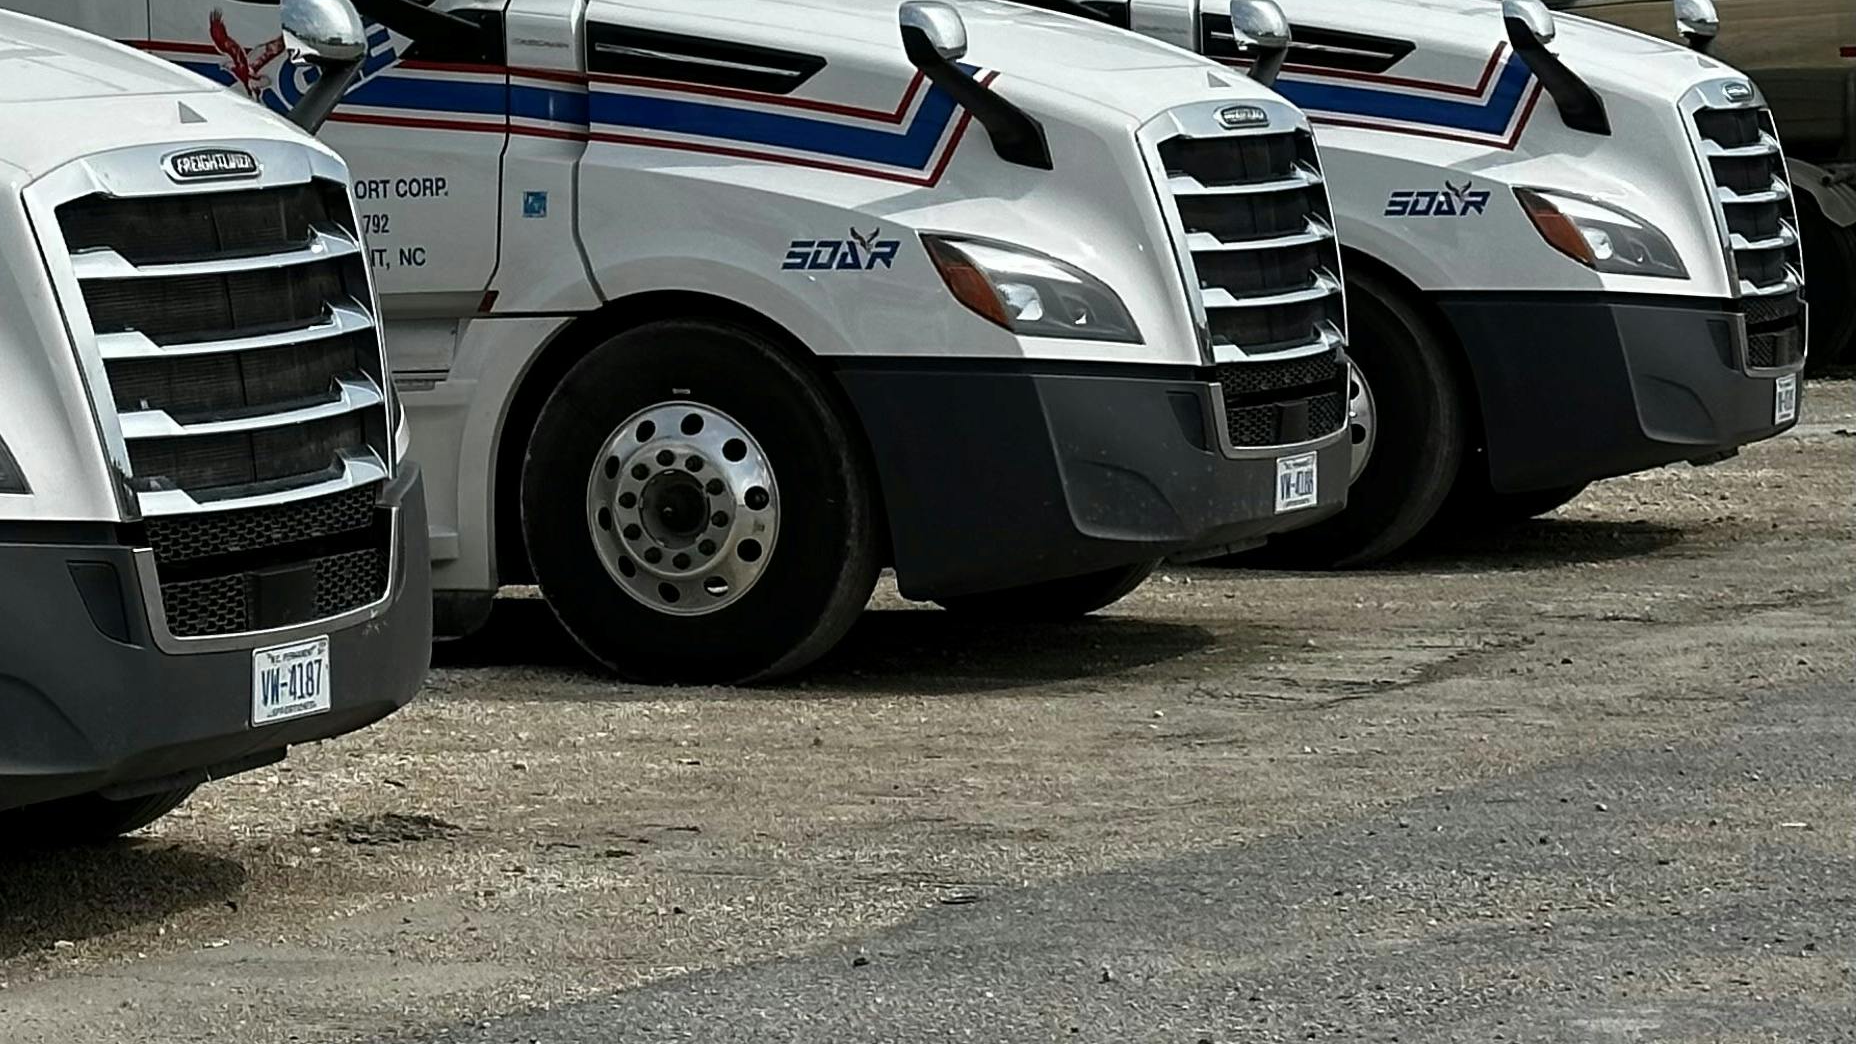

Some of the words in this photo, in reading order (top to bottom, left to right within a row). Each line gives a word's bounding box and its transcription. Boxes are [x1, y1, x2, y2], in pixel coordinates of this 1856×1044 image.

[354, 179, 391, 199] ORT
[395, 177, 448, 197] CORP.
[1384, 191, 1490, 216] SOAR
[363, 215, 389, 234] 792
[399, 247, 426, 266] NC
[781, 240, 901, 270] SOAR
[261, 658, 323, 707] VW-4187
